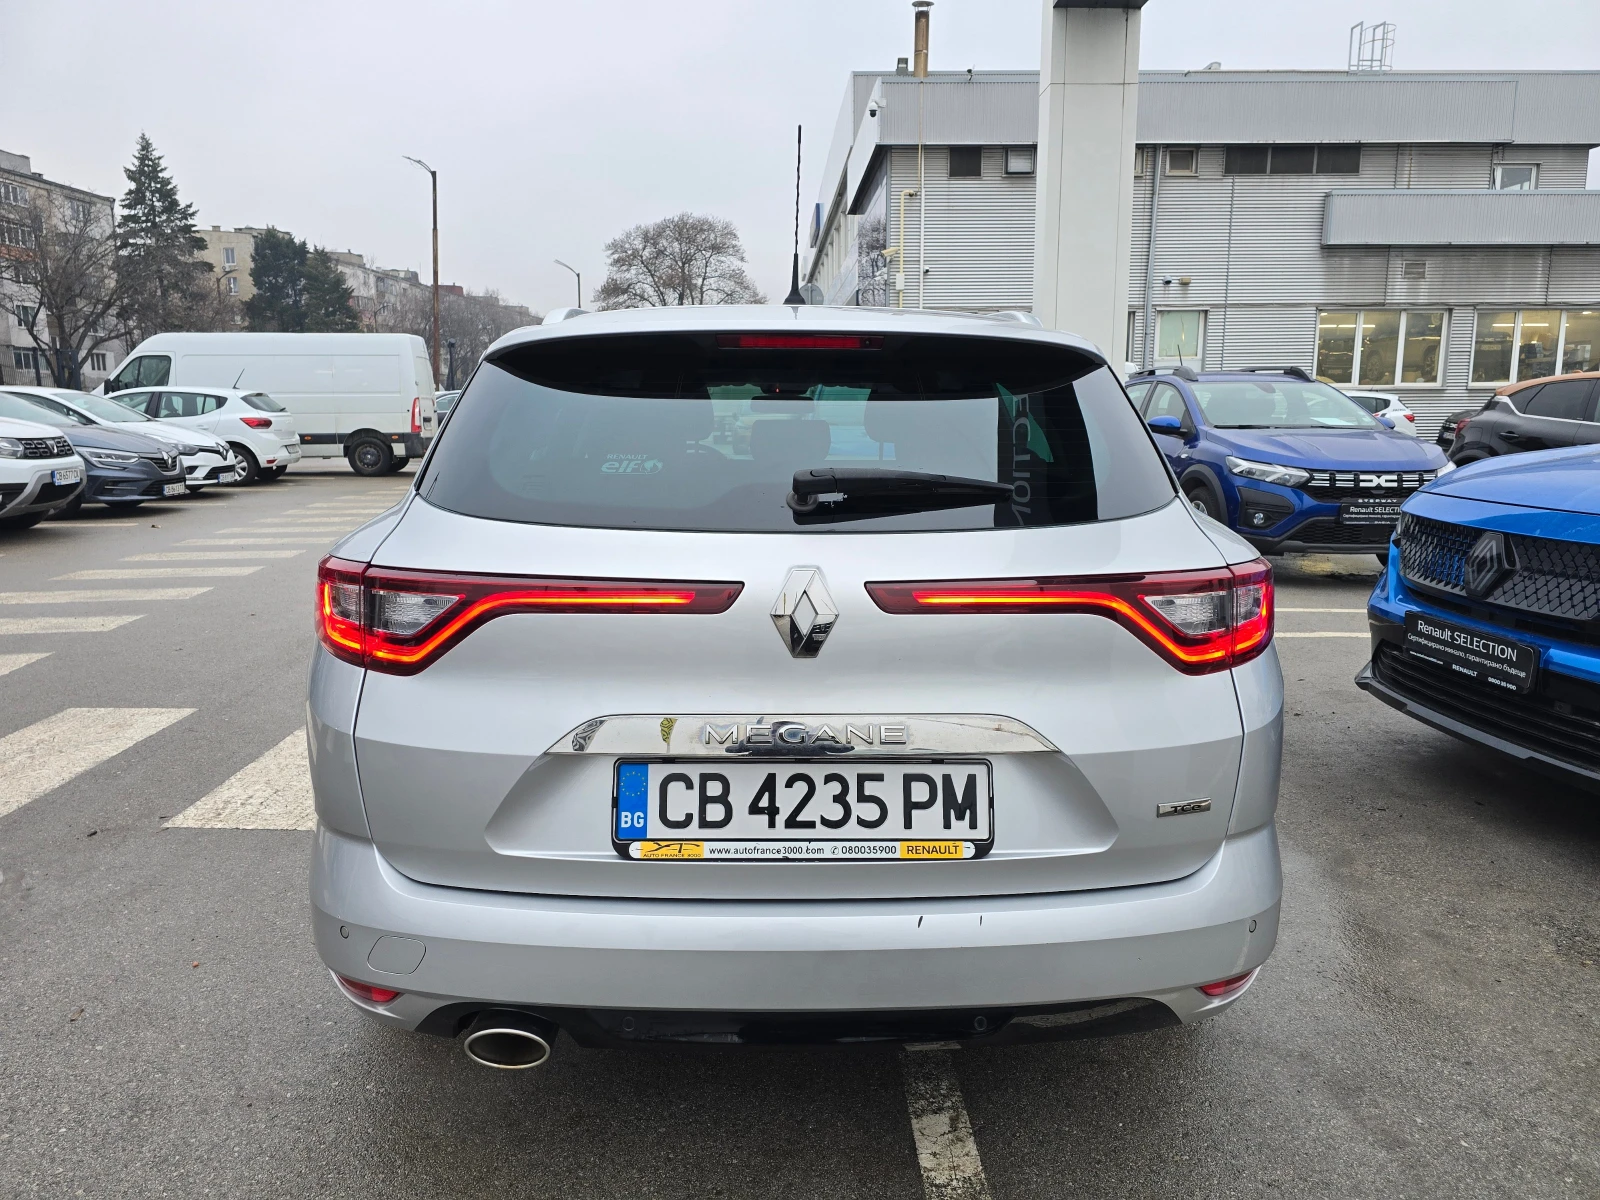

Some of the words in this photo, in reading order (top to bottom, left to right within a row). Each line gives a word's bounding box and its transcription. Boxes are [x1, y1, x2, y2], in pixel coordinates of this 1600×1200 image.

[601, 460, 642, 473] elf
[1374, 506, 1402, 514] SELECTI
[1417, 620, 1452, 642] Renault
[1454, 632, 1517, 662] SELECTION
[1452, 663, 1478, 678] RENAULT
[704, 723, 908, 745] MEGANE
[658, 772, 733, 829] CB
[748, 772, 888, 829] 4235
[902, 773, 978, 830] PM
[620, 812, 645, 828] BG
[709, 845, 825, 855] www.autofrance3000.com
[841, 845, 897, 855] 080035900
[906, 845, 960, 855] RENAULT
